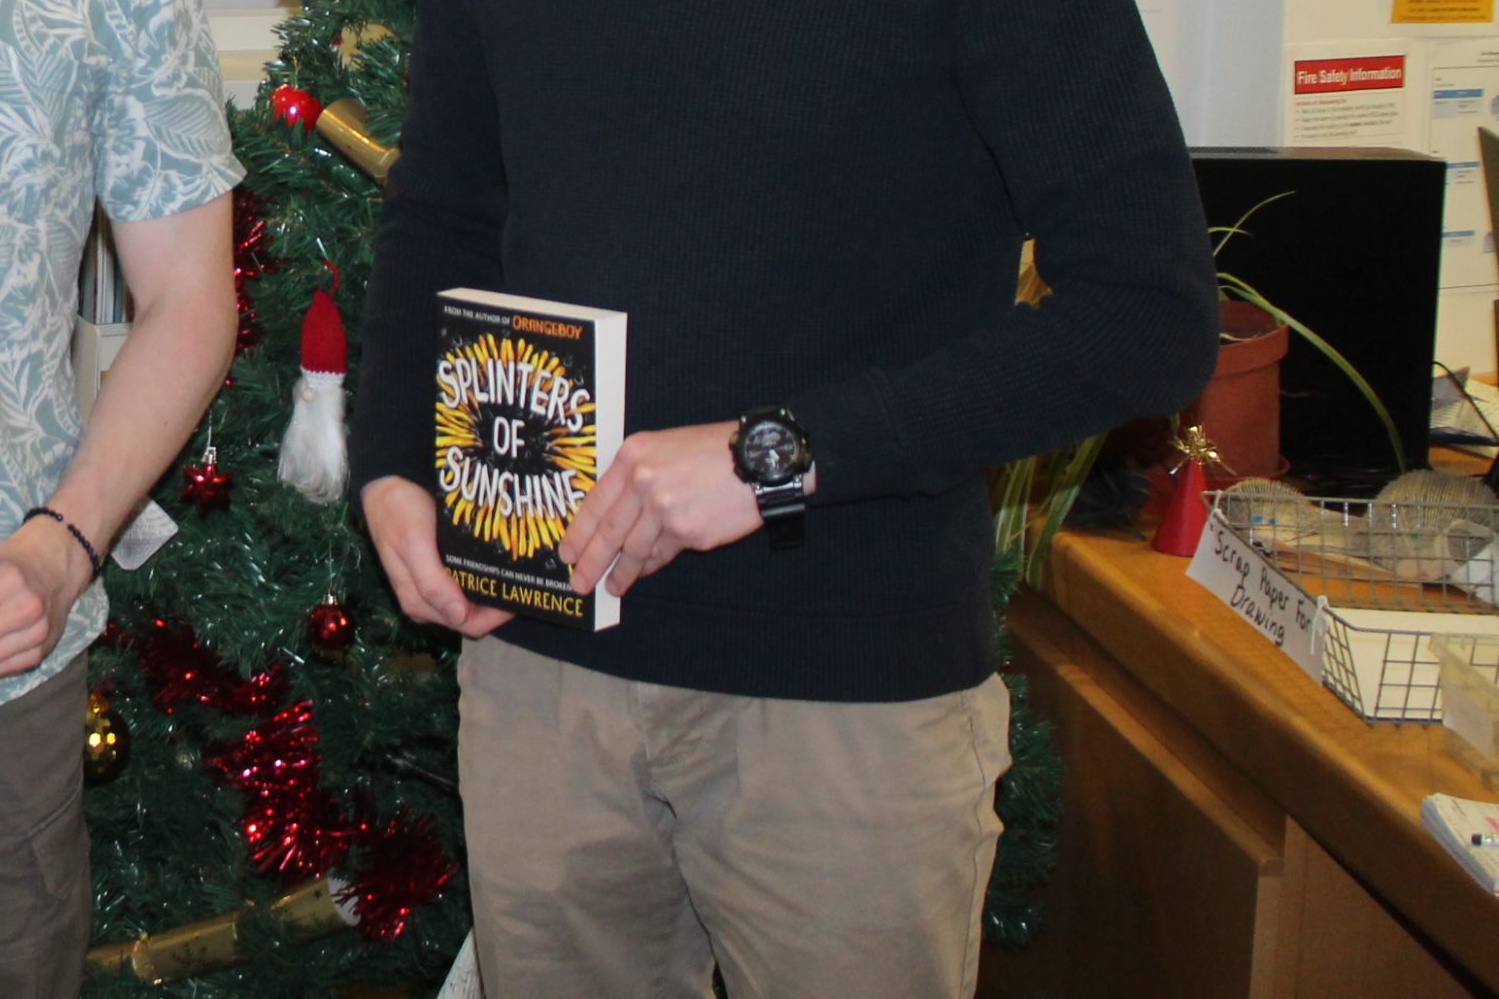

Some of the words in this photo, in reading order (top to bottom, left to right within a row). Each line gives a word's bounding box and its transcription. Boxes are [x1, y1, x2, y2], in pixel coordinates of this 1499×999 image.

[1297, 70, 1317, 84] Fire
[1319, 69, 1348, 86] Safety
[1349, 67, 1402, 81] Information
[443, 306, 462, 316] FROM
[463, 309, 474, 318] THE
[475, 312, 500, 323] AUTHOR
[501, 316, 510, 325] OF
[512, 315, 583, 339] ORANGEBOY
[439, 357, 591, 432] SPLINTERS
[493, 416, 525, 459] OF
[439, 446, 585, 520] SUNSHINE
[445, 554, 462, 565] SOME
[463, 557, 500, 575] FRIENDSHIPS
[501, 568, 514, 578] CAN
[515, 571, 535, 583] NEVER
[536, 577, 544, 586] BE
[1214, 530, 1250, 585] Scrap
[1260, 567, 1290, 611] Paper
[1295, 599, 1312, 633] For
[502, 582, 584, 618] LAWRENCE
[1231, 584, 1285, 646] Drawing
